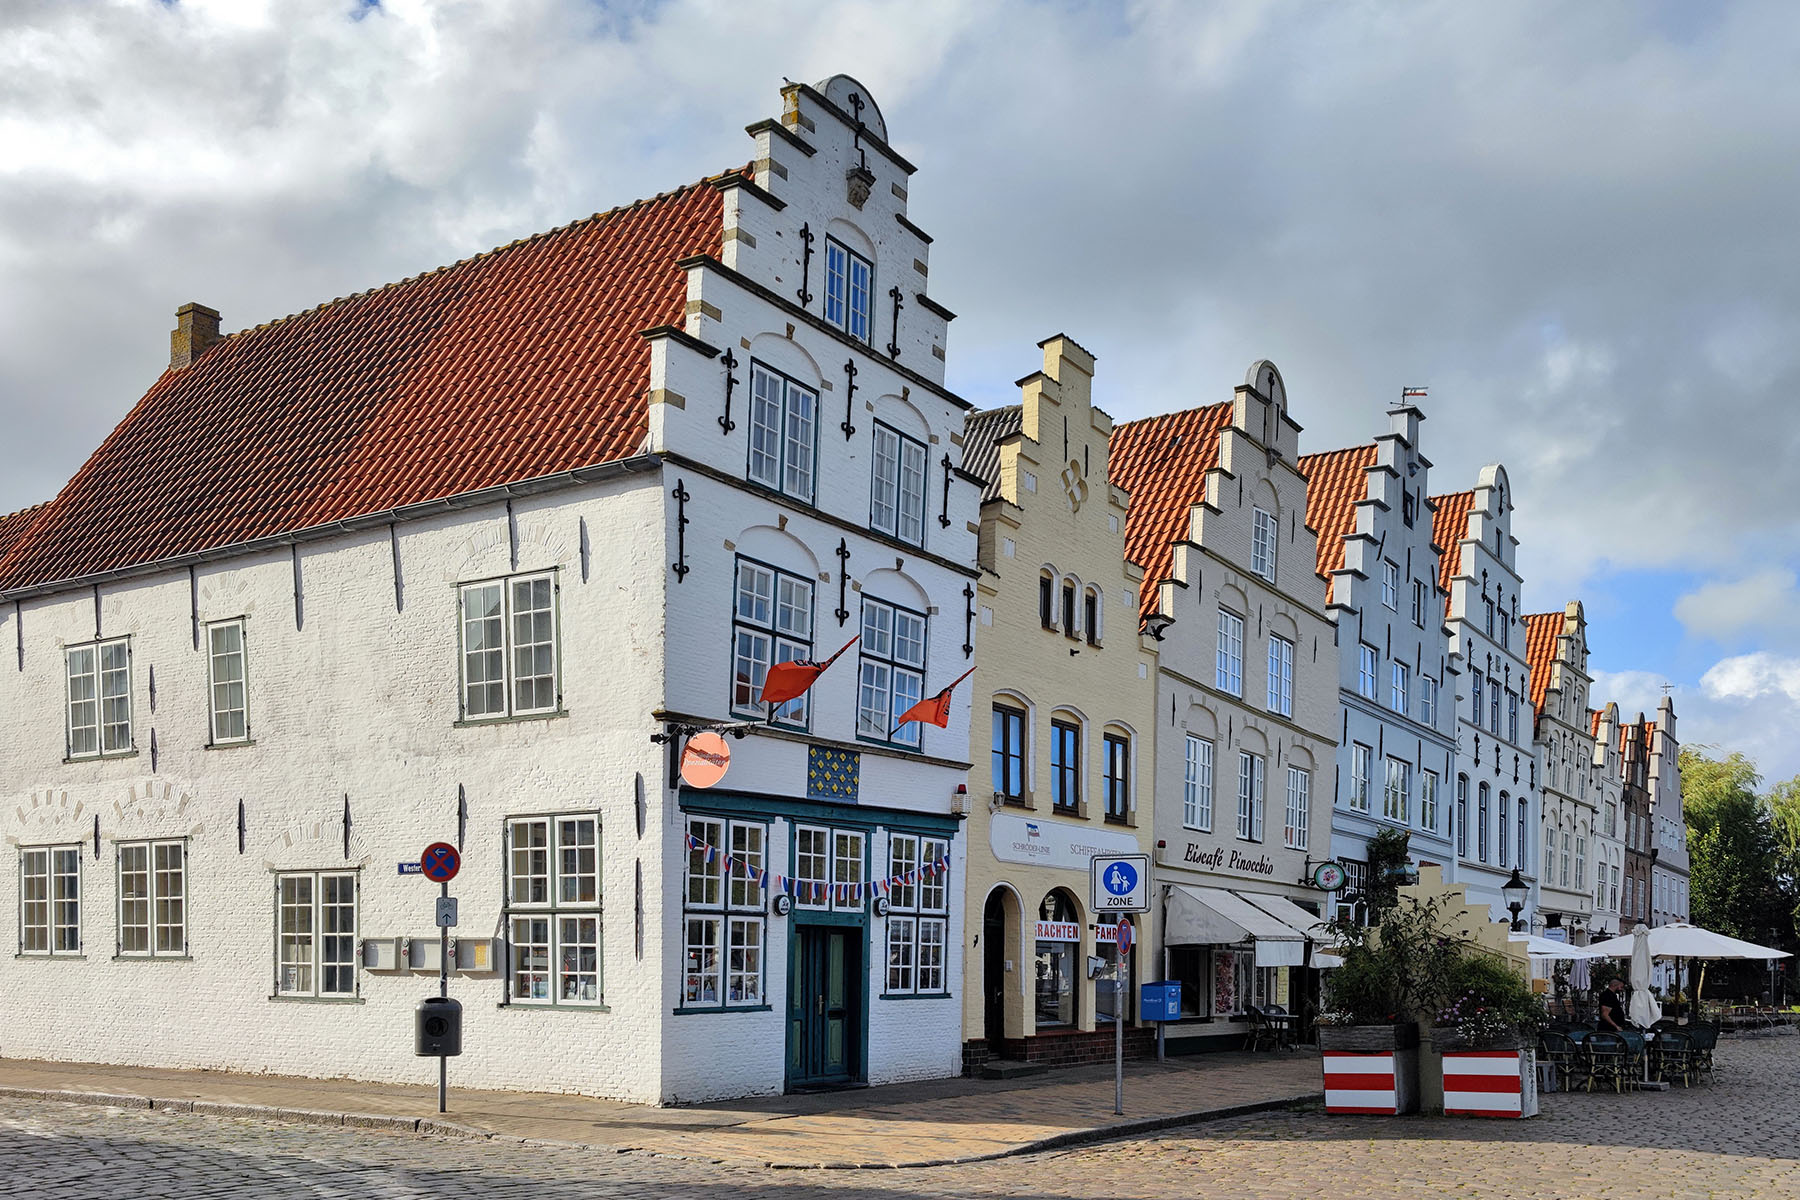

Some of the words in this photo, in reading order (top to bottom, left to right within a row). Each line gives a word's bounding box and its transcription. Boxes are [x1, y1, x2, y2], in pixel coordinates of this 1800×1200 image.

[1184, 843, 1224, 871] Eiscafé
[1228, 850, 1273, 875] Pinocchio
[402, 863, 423, 873] Wester
[1107, 897, 1133, 906] ZONE
[1035, 923, 1078, 939] RACHTEN
[1095, 925, 1117, 940] FAHR
